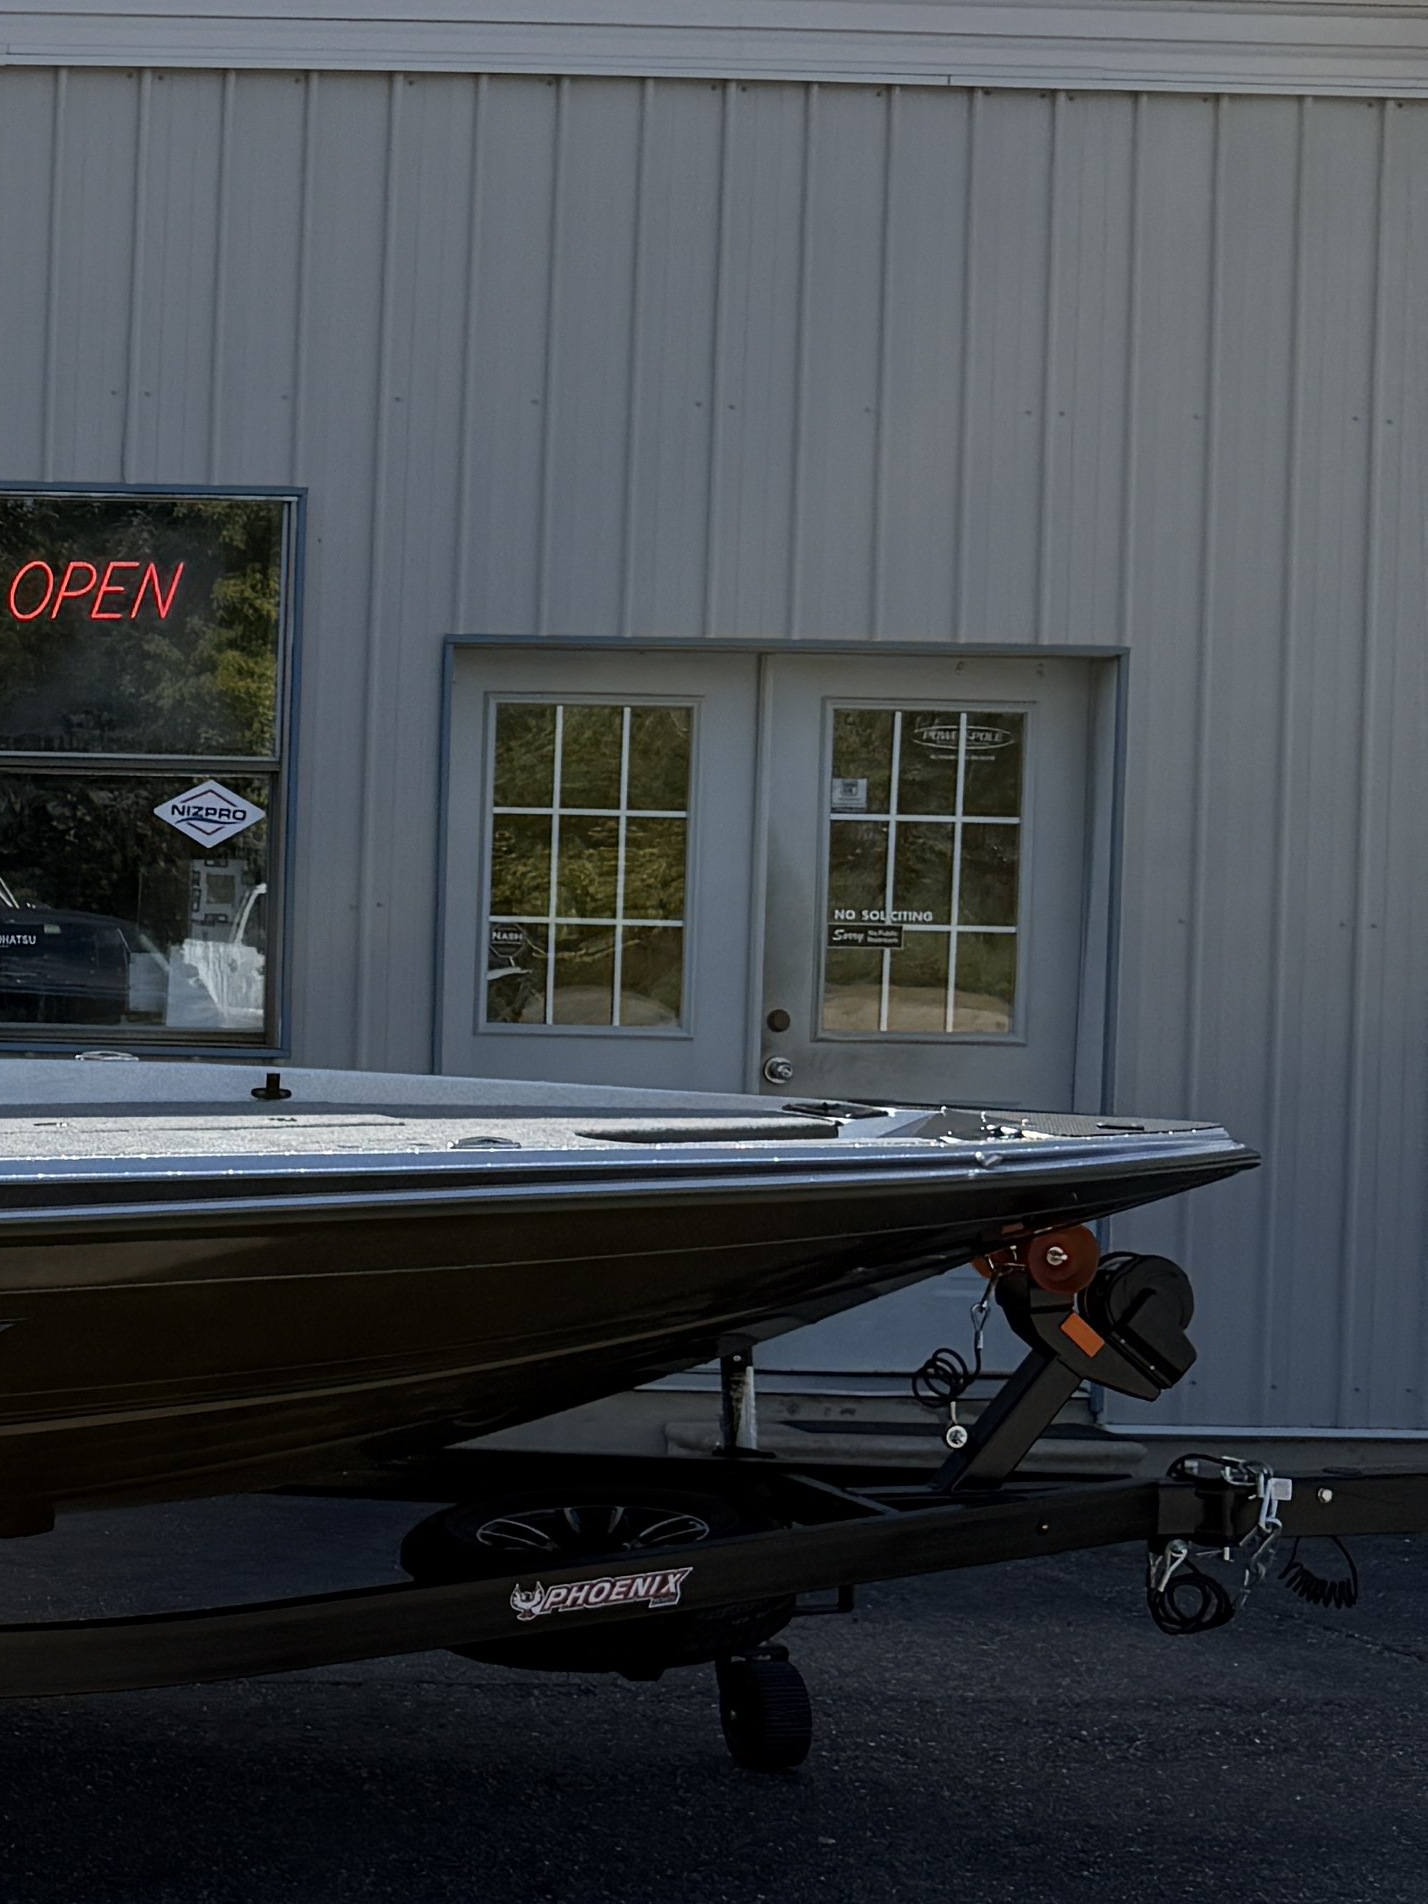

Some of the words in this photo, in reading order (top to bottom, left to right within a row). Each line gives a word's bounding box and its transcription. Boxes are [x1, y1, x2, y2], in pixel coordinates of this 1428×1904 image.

[8, 559, 185, 623] OPEN
[170, 803, 247, 822] NIZPRO
[834, 909, 856, 920] NO
[861, 910, 933, 922] SOLCITING
[544, 1571, 684, 1610] PHOENIX
